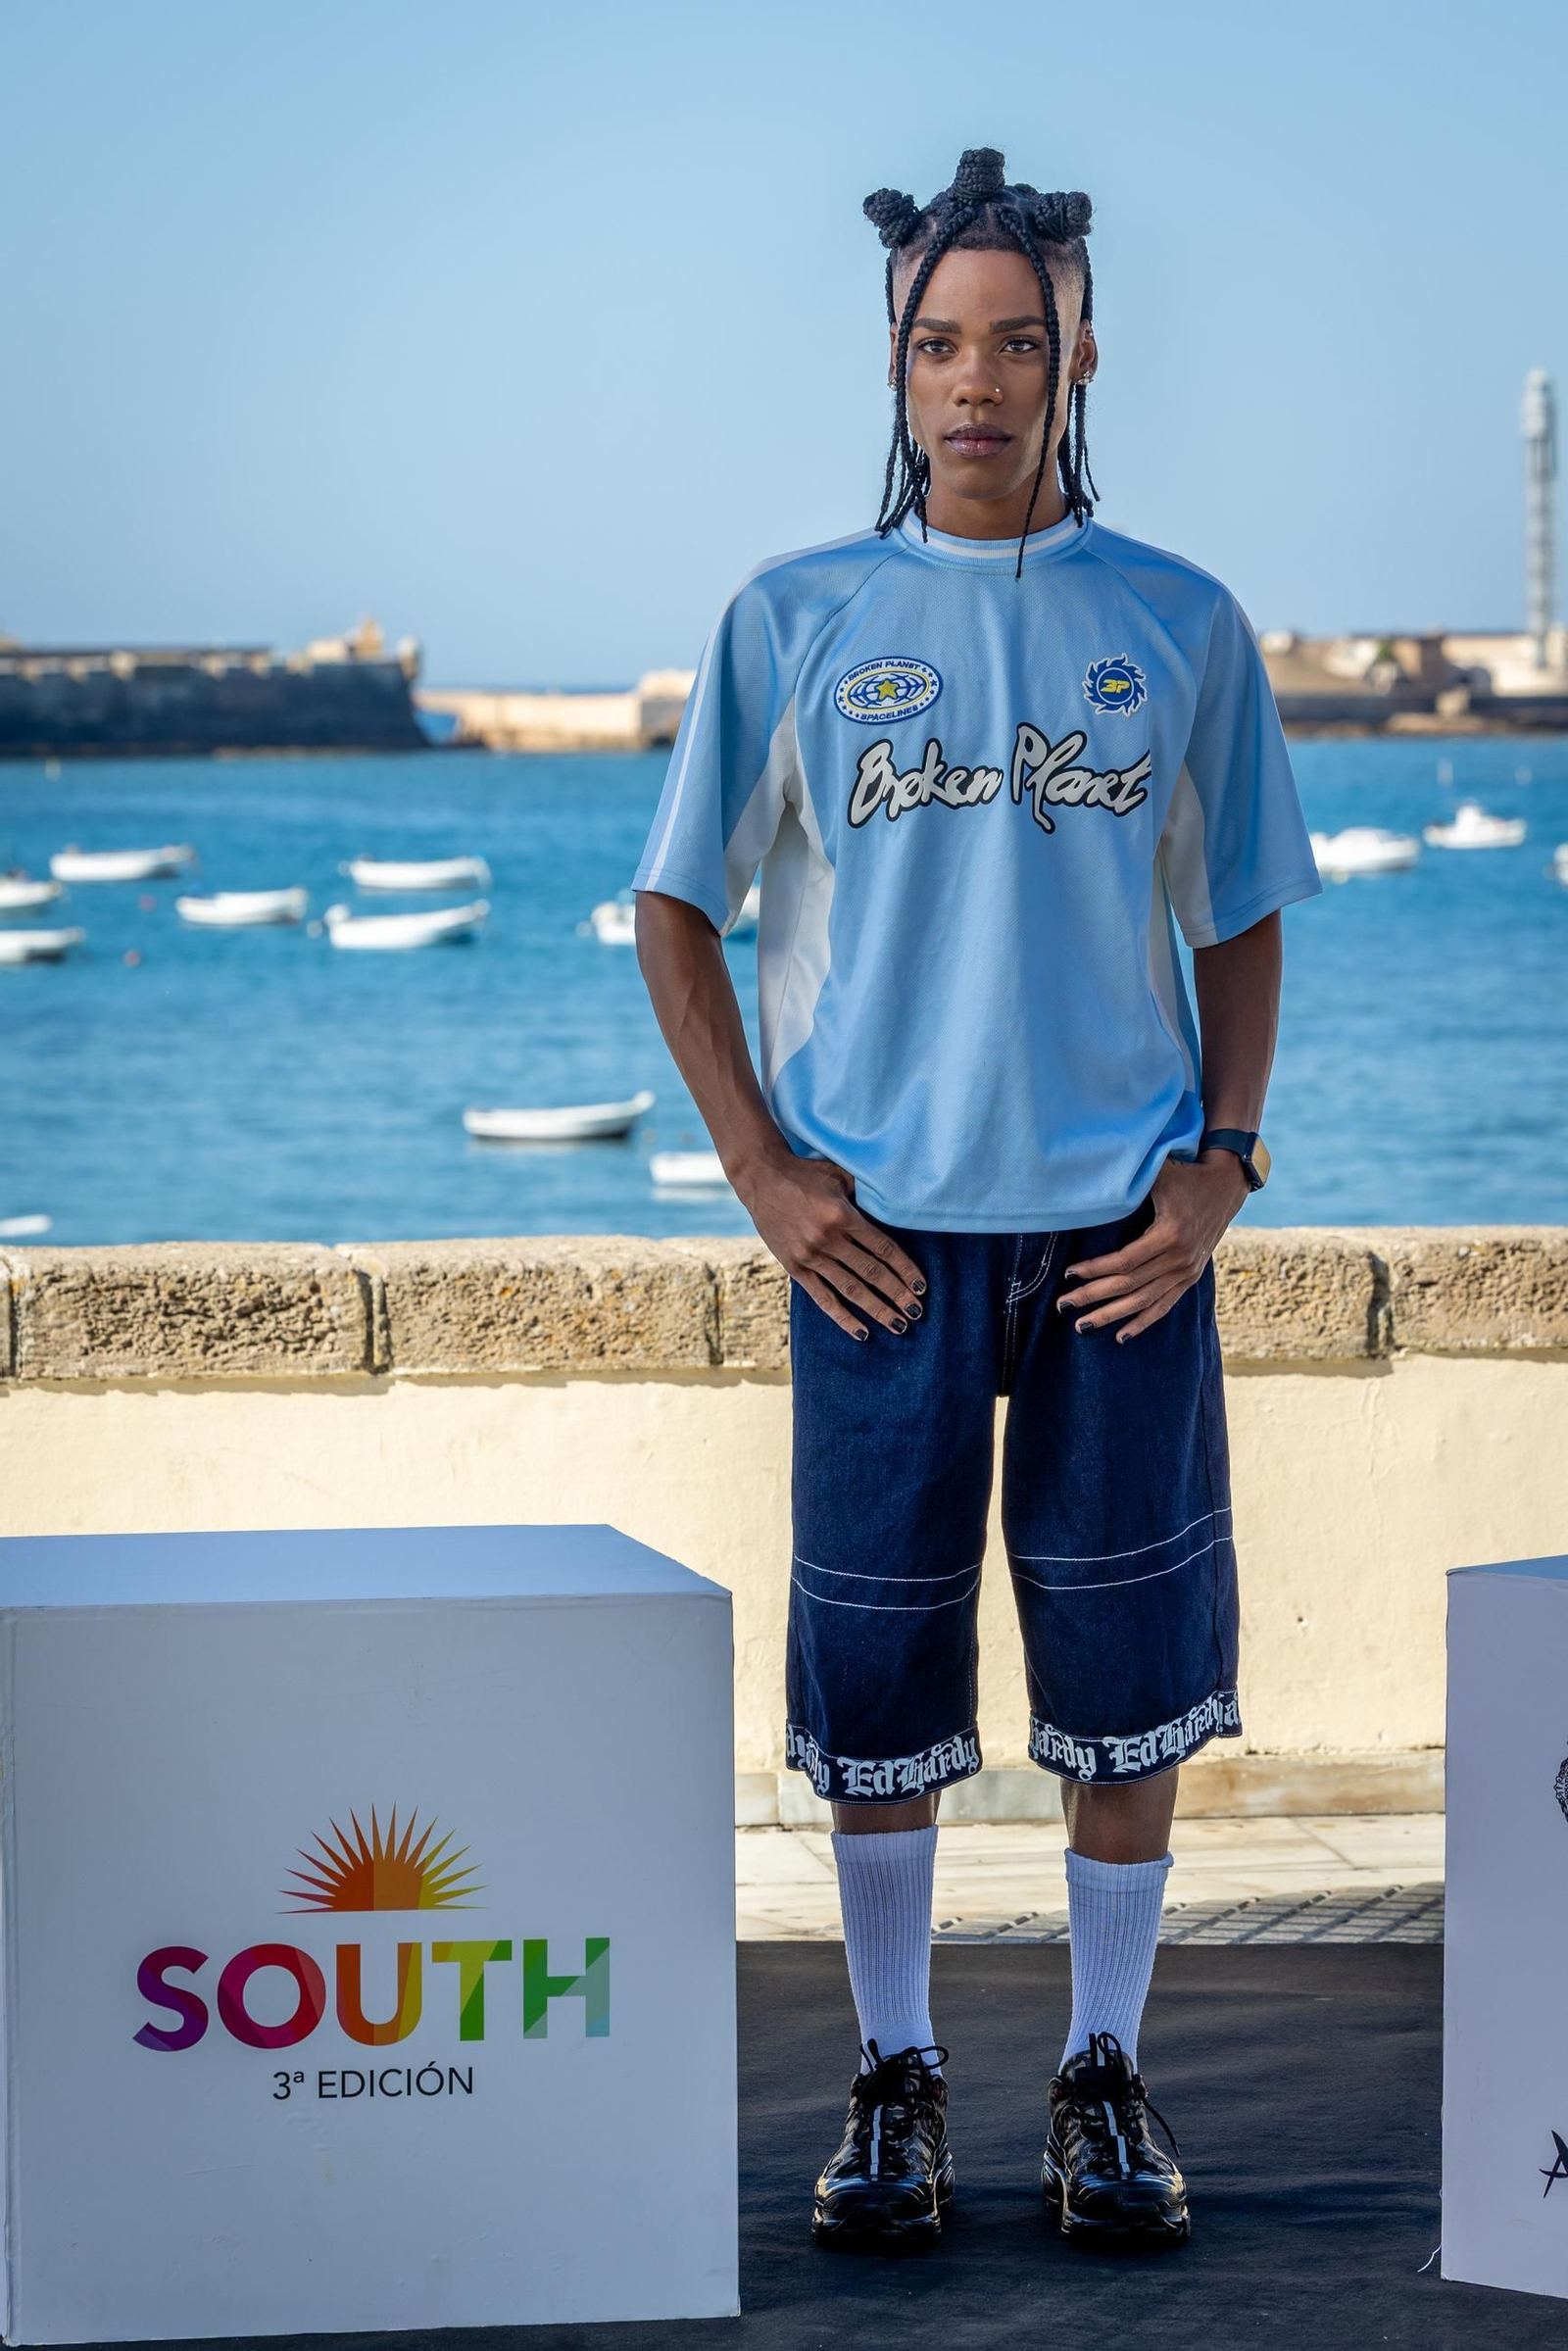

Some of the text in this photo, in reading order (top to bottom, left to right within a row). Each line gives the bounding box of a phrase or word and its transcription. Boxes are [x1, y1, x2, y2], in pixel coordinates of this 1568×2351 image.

[847, 661, 921, 682] BROKEN PLANET
[860, 705, 919, 721] SPACELINES
[848, 722, 1152, 834] Broken Planet
[132, 1937, 611, 2052] SOUTH
[272, 2061, 474, 2100] 3ª EDICIÓN
